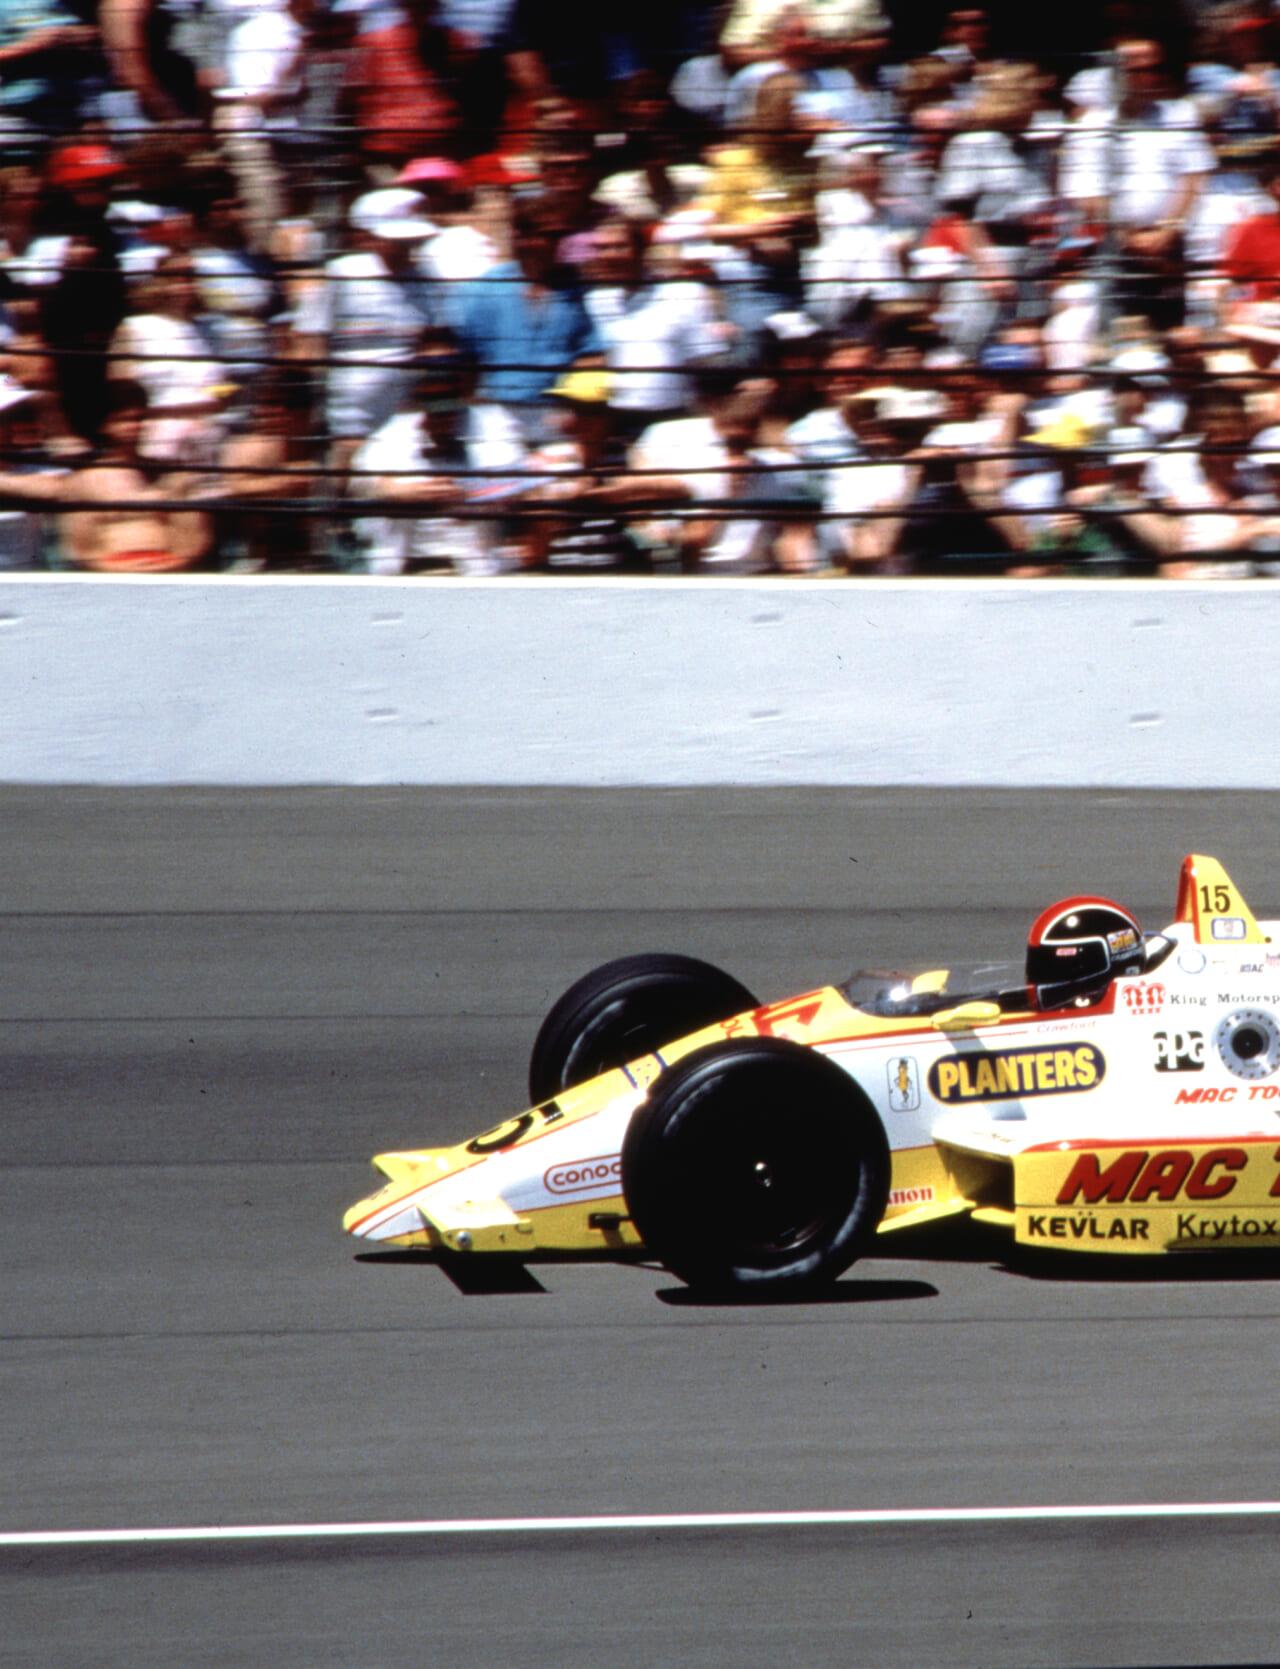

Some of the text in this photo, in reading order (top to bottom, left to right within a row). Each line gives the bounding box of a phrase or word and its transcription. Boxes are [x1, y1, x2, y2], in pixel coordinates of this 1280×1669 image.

[1200, 885, 1231, 914] 15
[1170, 993, 1208, 1006] King
[936, 1045, 1098, 1100] PLANTERS
[1174, 1088, 1238, 1105] MAC
[553, 1161, 624, 1186] conoc
[1055, 1147, 1248, 1206] MAC
[888, 1187, 932, 1205] non
[1028, 1215, 1150, 1240] KEVLAR
[1176, 1214, 1278, 1242] Krytox
